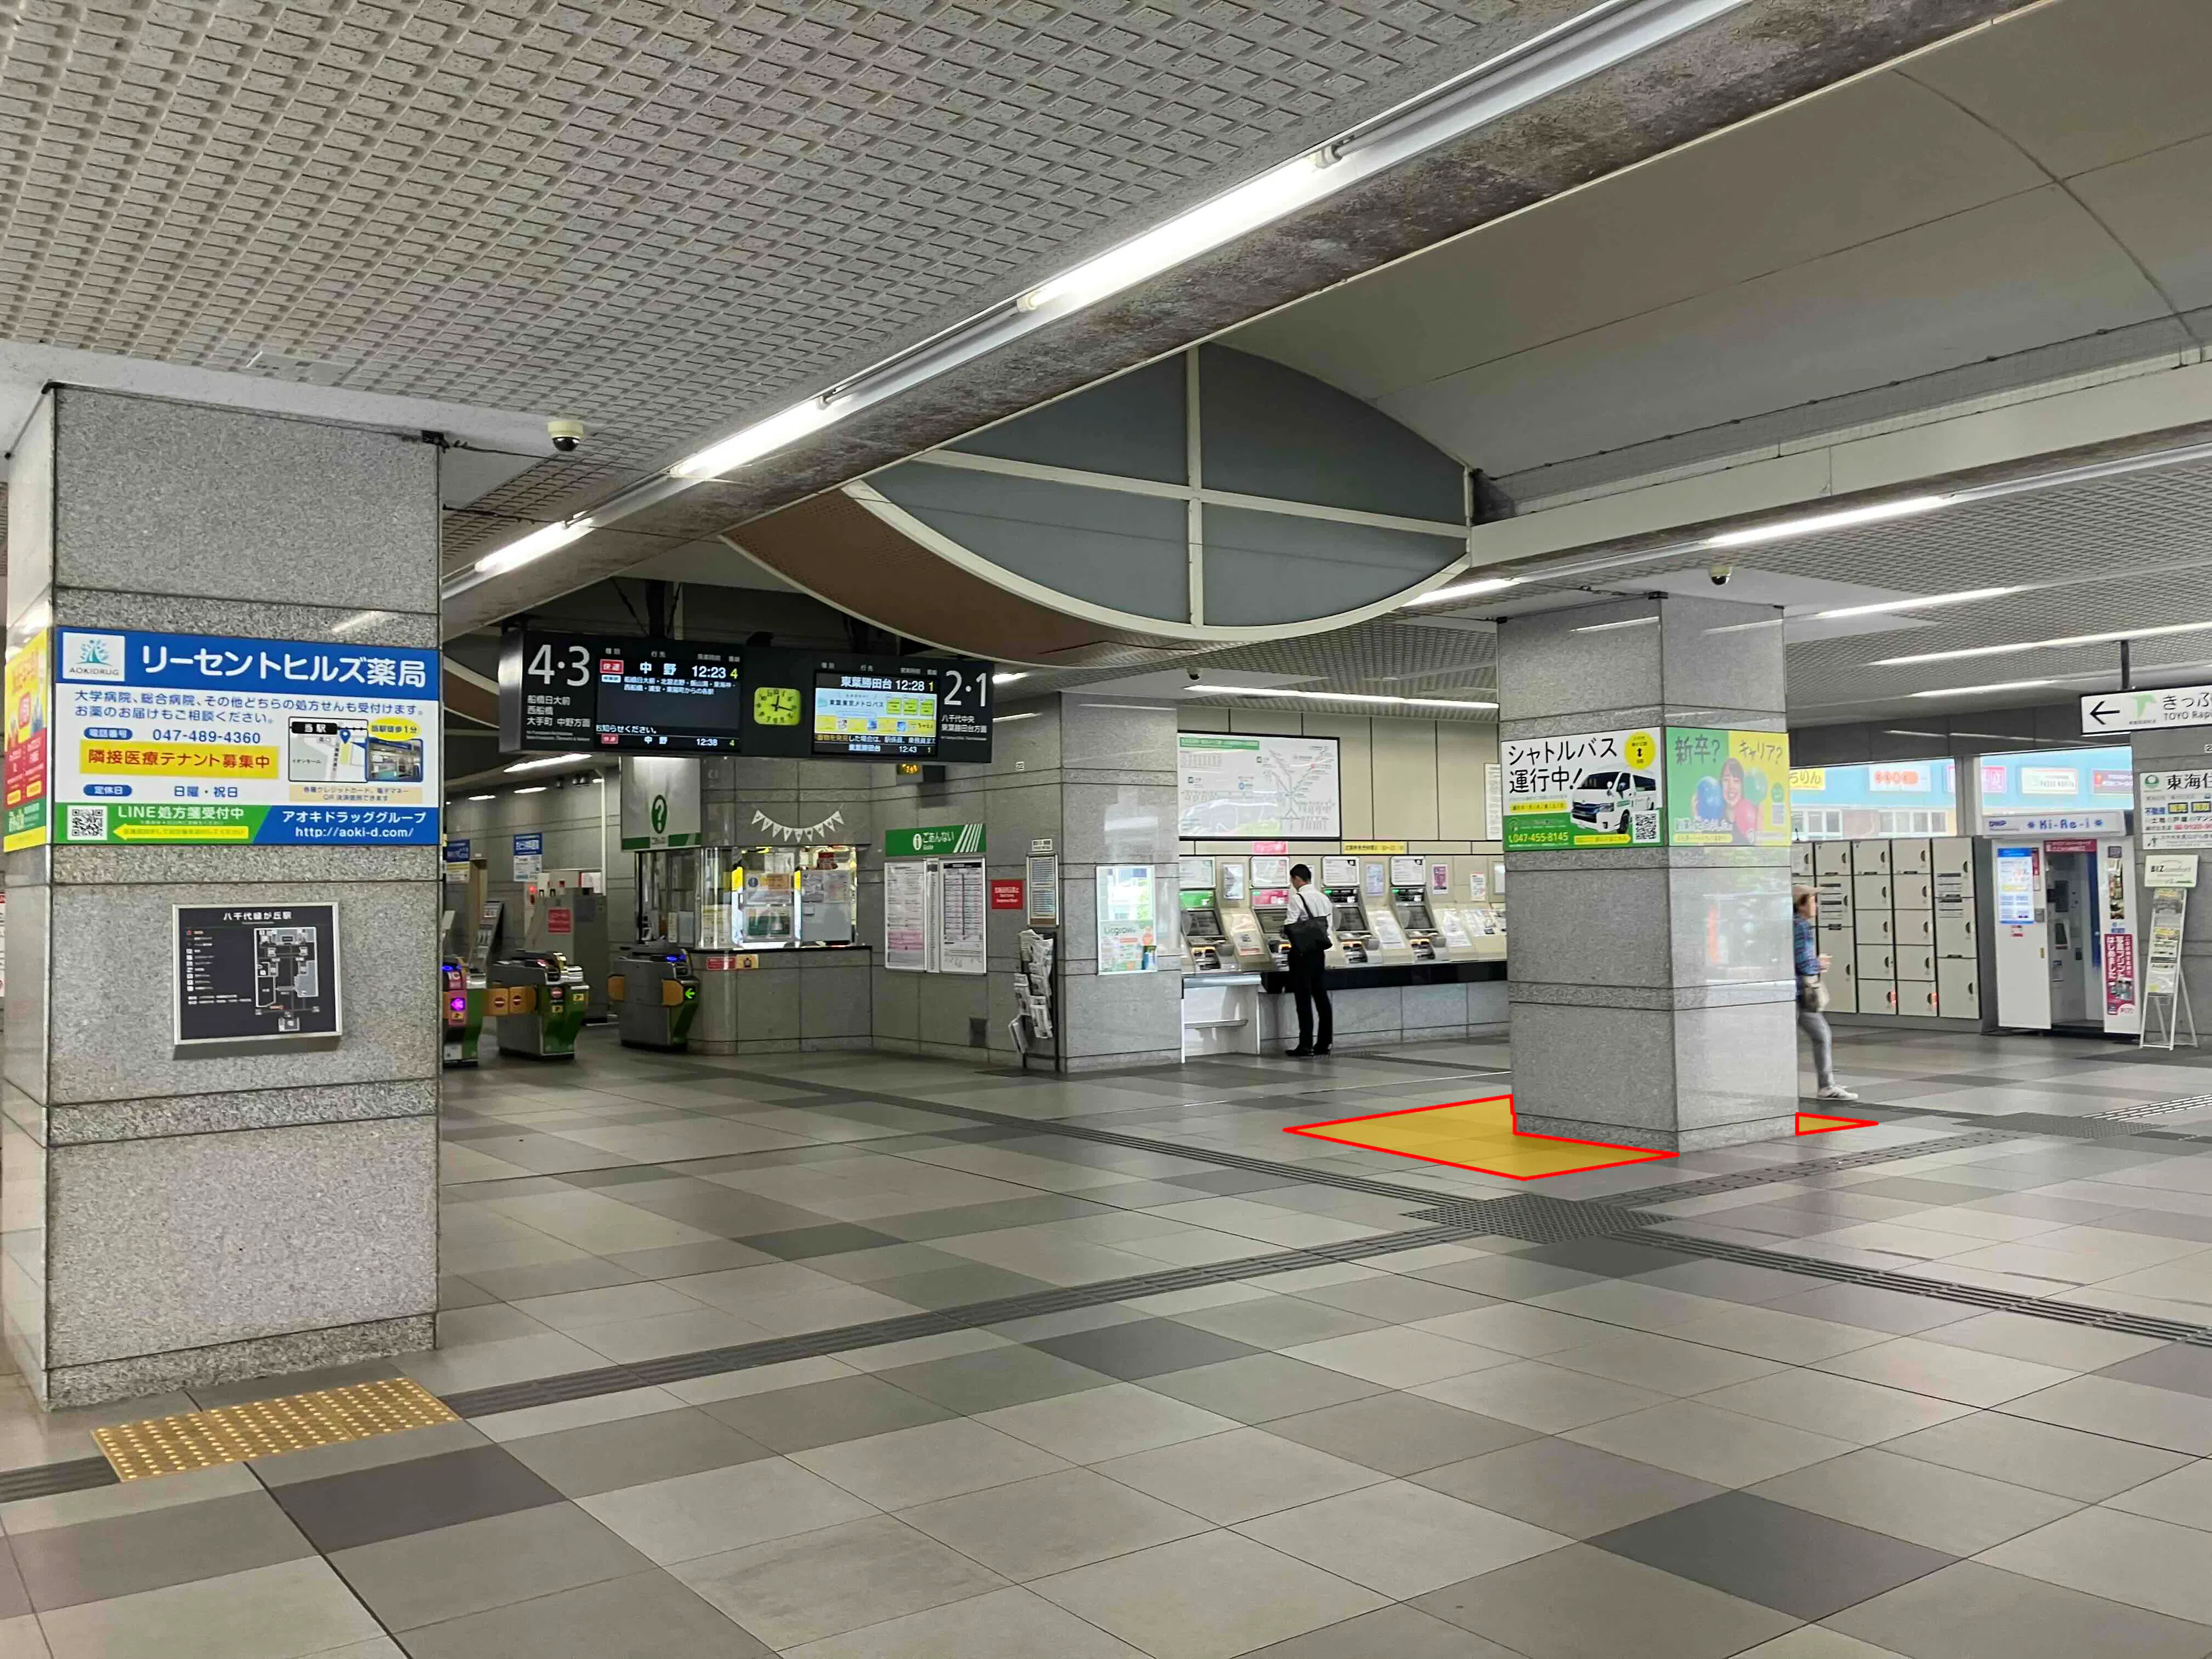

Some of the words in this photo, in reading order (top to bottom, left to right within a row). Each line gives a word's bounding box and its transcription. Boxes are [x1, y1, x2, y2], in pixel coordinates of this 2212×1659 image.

[70, 668, 119, 676] AOKIDRUG
[143, 645, 426, 688] リーセントヒルズ薬局
[691, 665, 727, 679] 12:23
[729, 668, 739, 679] 4
[895, 679, 925, 692] 12:28
[928, 681, 934, 692] 1
[74, 705, 274, 724] お薬のお届けもご相談ください。
[527, 716, 553, 726] 大手町
[2164, 711, 2189, 721] TOYO
[153, 729, 261, 744] 047-489-4360
[1508, 737, 1617, 766] シャトルバス
[1739, 739, 1783, 765] キャリア?
[88, 749, 270, 769] 隣接医療テナント募集中
[1509, 765, 1583, 794] 運行中!
[94, 786, 123, 795] 定休日
[174, 786, 238, 798] 日曜・祝日
[282, 810, 427, 824] アオキドラッググループ
[295, 826, 414, 838] http://aoki-d.com/
